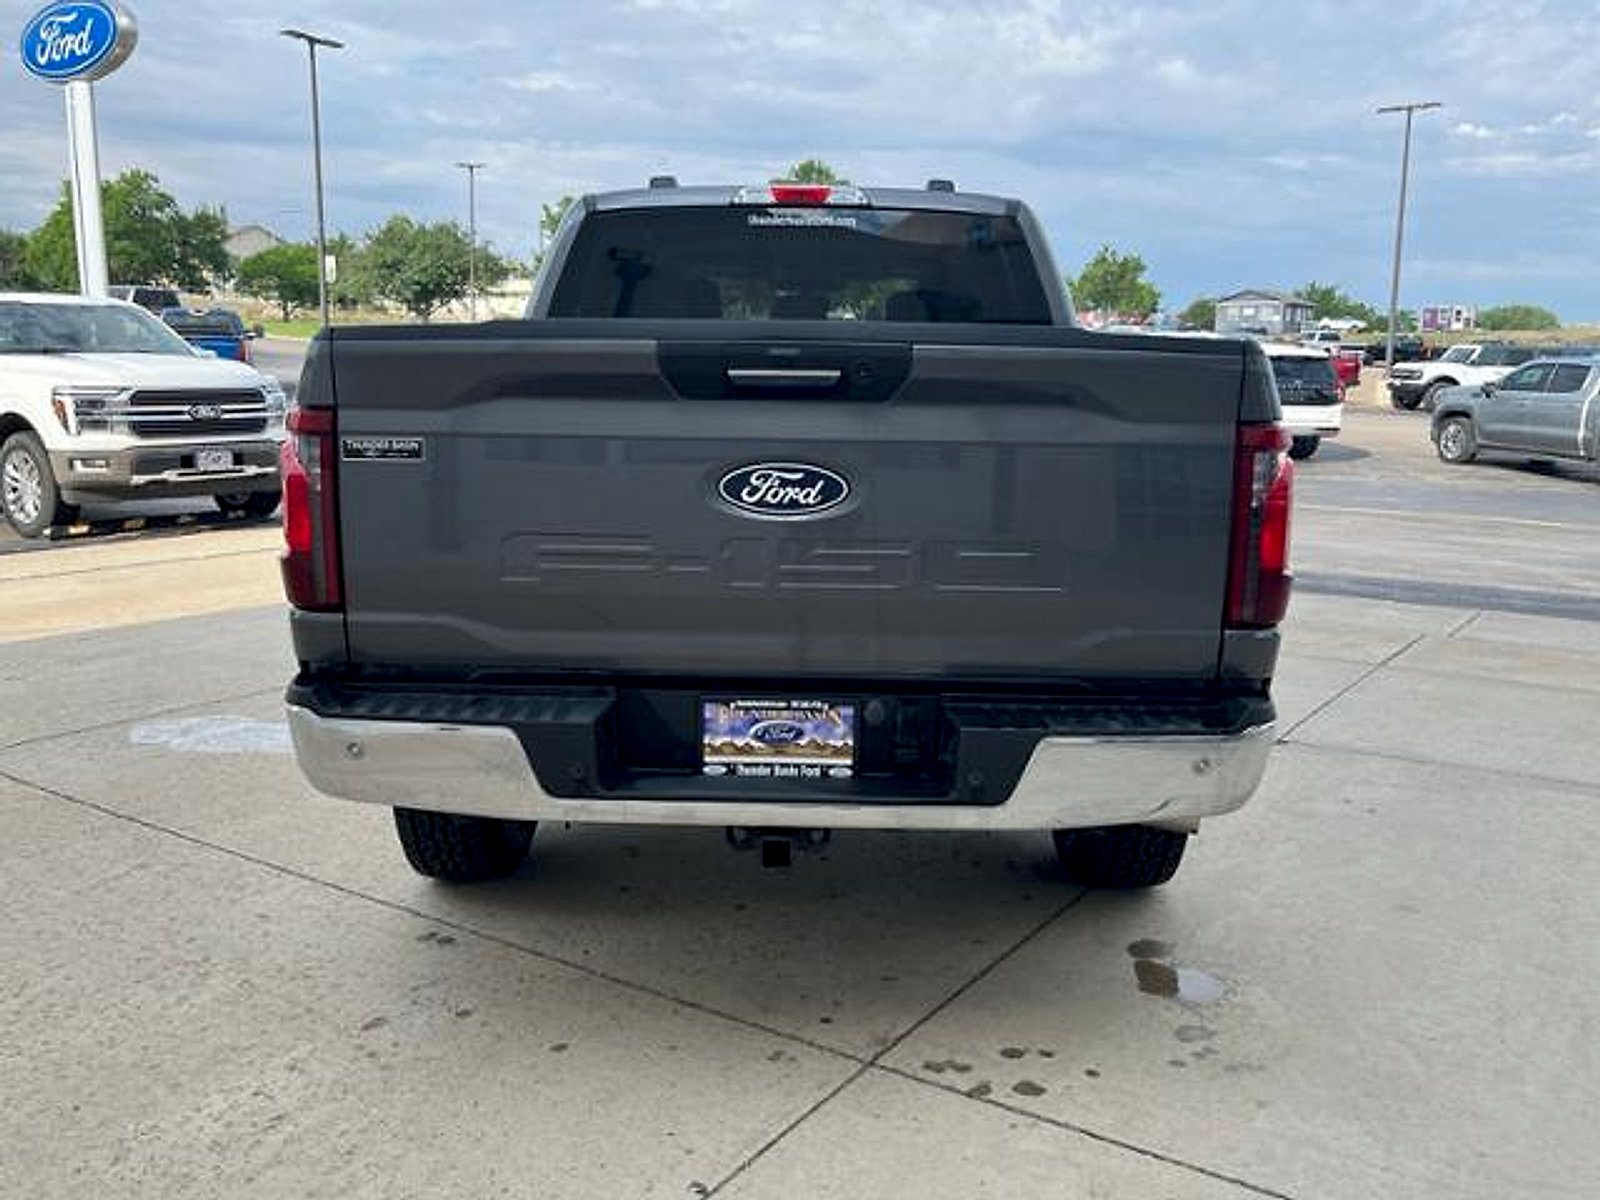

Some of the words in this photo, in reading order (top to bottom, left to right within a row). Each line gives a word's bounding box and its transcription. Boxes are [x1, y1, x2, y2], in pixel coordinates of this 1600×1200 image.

[36, 12, 94, 65] Ford
[741, 470, 824, 504] Ford
[500, 531, 1066, 591] F-150
